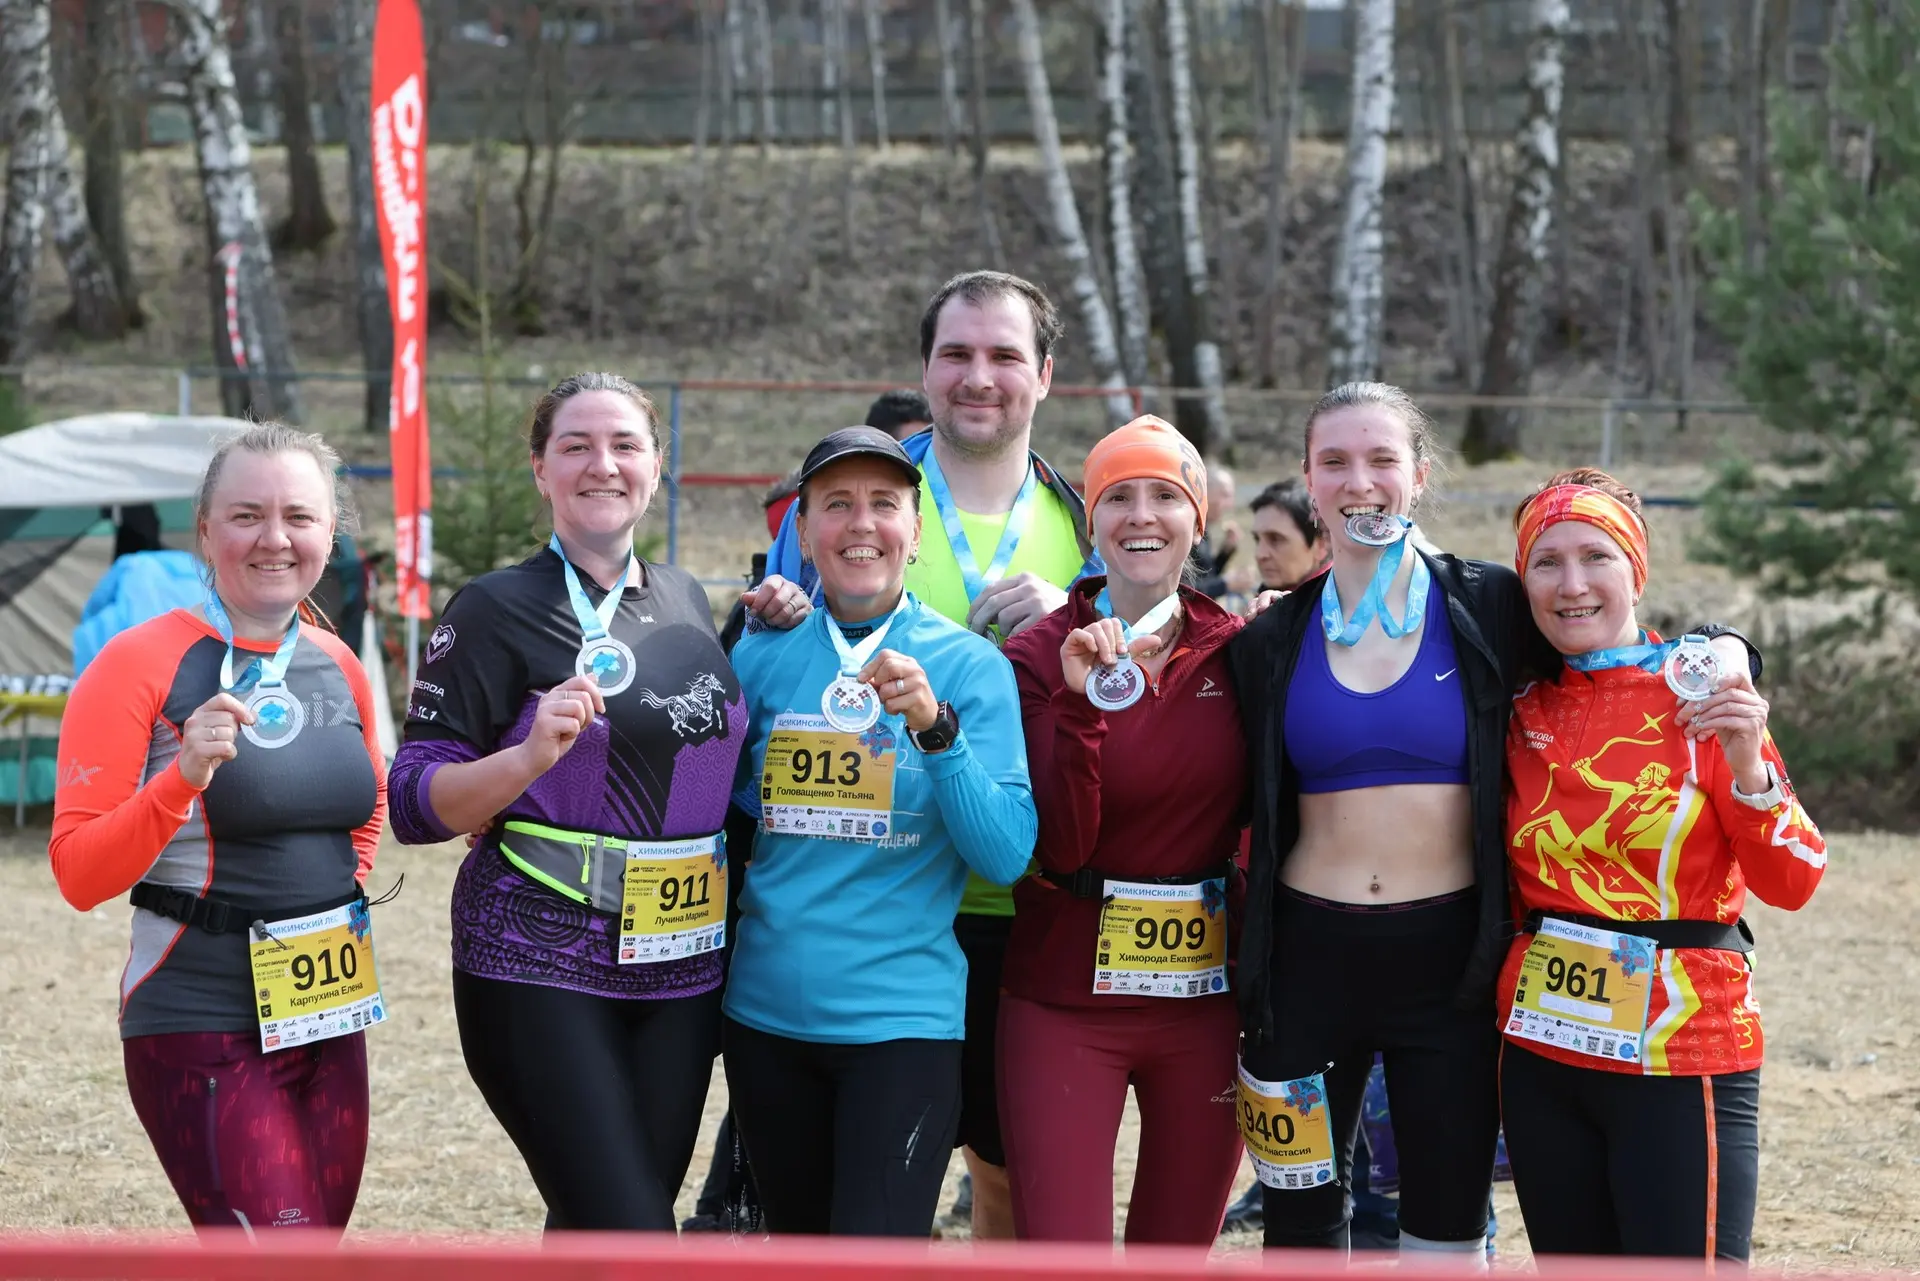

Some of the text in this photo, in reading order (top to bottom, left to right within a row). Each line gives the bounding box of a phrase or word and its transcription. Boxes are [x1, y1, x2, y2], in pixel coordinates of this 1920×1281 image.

[791, 748, 862, 786] 913
[776, 786, 875, 801] Головащенко Татьяна
[638, 843, 707, 856] ХИМКИНСКИЙ ЛЕС
[659, 871, 710, 912] 911
[1112, 886, 1195, 897] ХИМКИНСКИЙ ЛЕС
[268, 914, 340, 936] ИМКИНСКИЙ ЛЕС
[655, 909, 710, 926] Лучина Марина
[1135, 917, 1206, 950] 909
[1583, 931, 1600, 943] ЛЕС
[291, 942, 358, 991] 910
[1118, 951, 1213, 964] Химорода Екатерина
[1545, 956, 1611, 1004] 961
[289, 988, 340, 1008] Карпухина
[341, 981, 364, 995] Елена
[1243, 1099, 1295, 1145] 940
[1264, 1146, 1312, 1158] Анастасия
